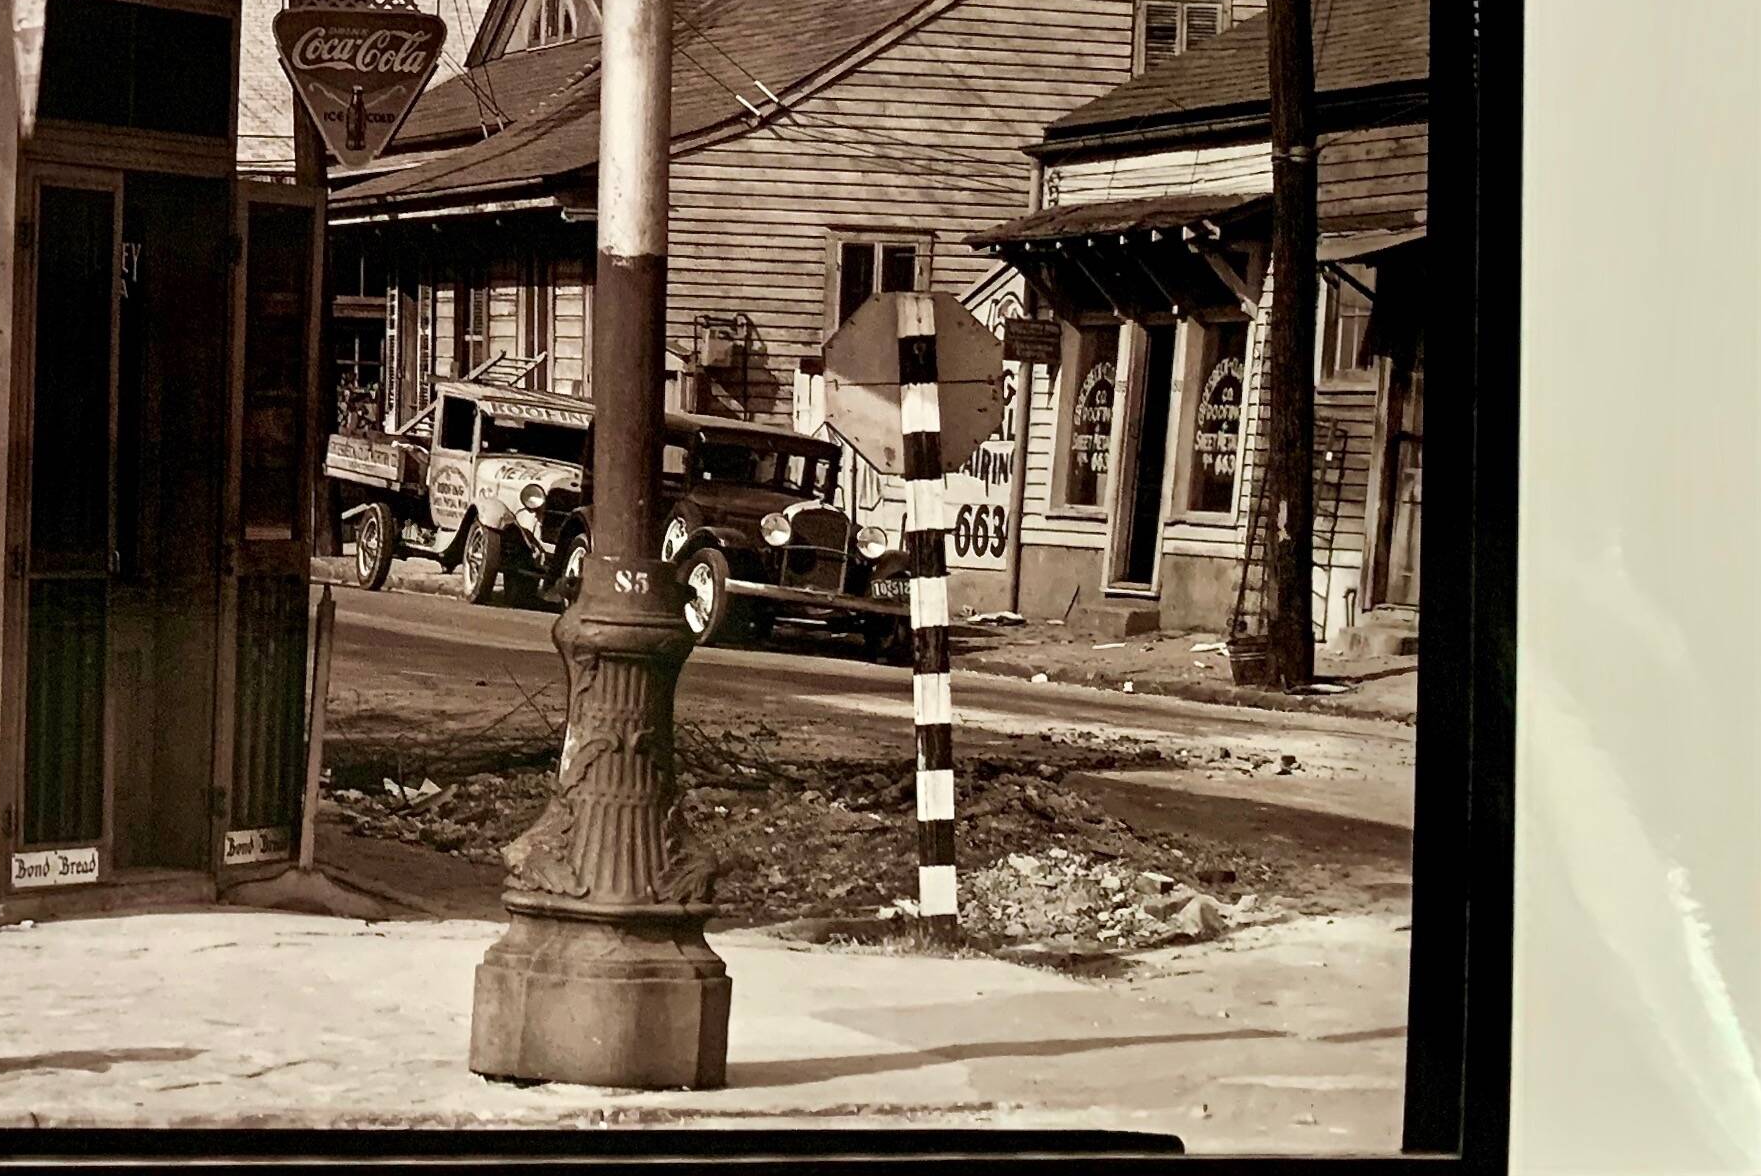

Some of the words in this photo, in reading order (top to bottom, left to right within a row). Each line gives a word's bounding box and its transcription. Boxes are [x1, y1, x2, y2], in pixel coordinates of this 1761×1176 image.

[291, 26, 433, 73] Coca-Cola
[323, 111, 345, 123] ICE
[367, 112, 395, 124] COLD
[954, 504, 1006, 558] 663
[15, 855, 51, 879] Bond
[58, 852, 97, 876] Bread
